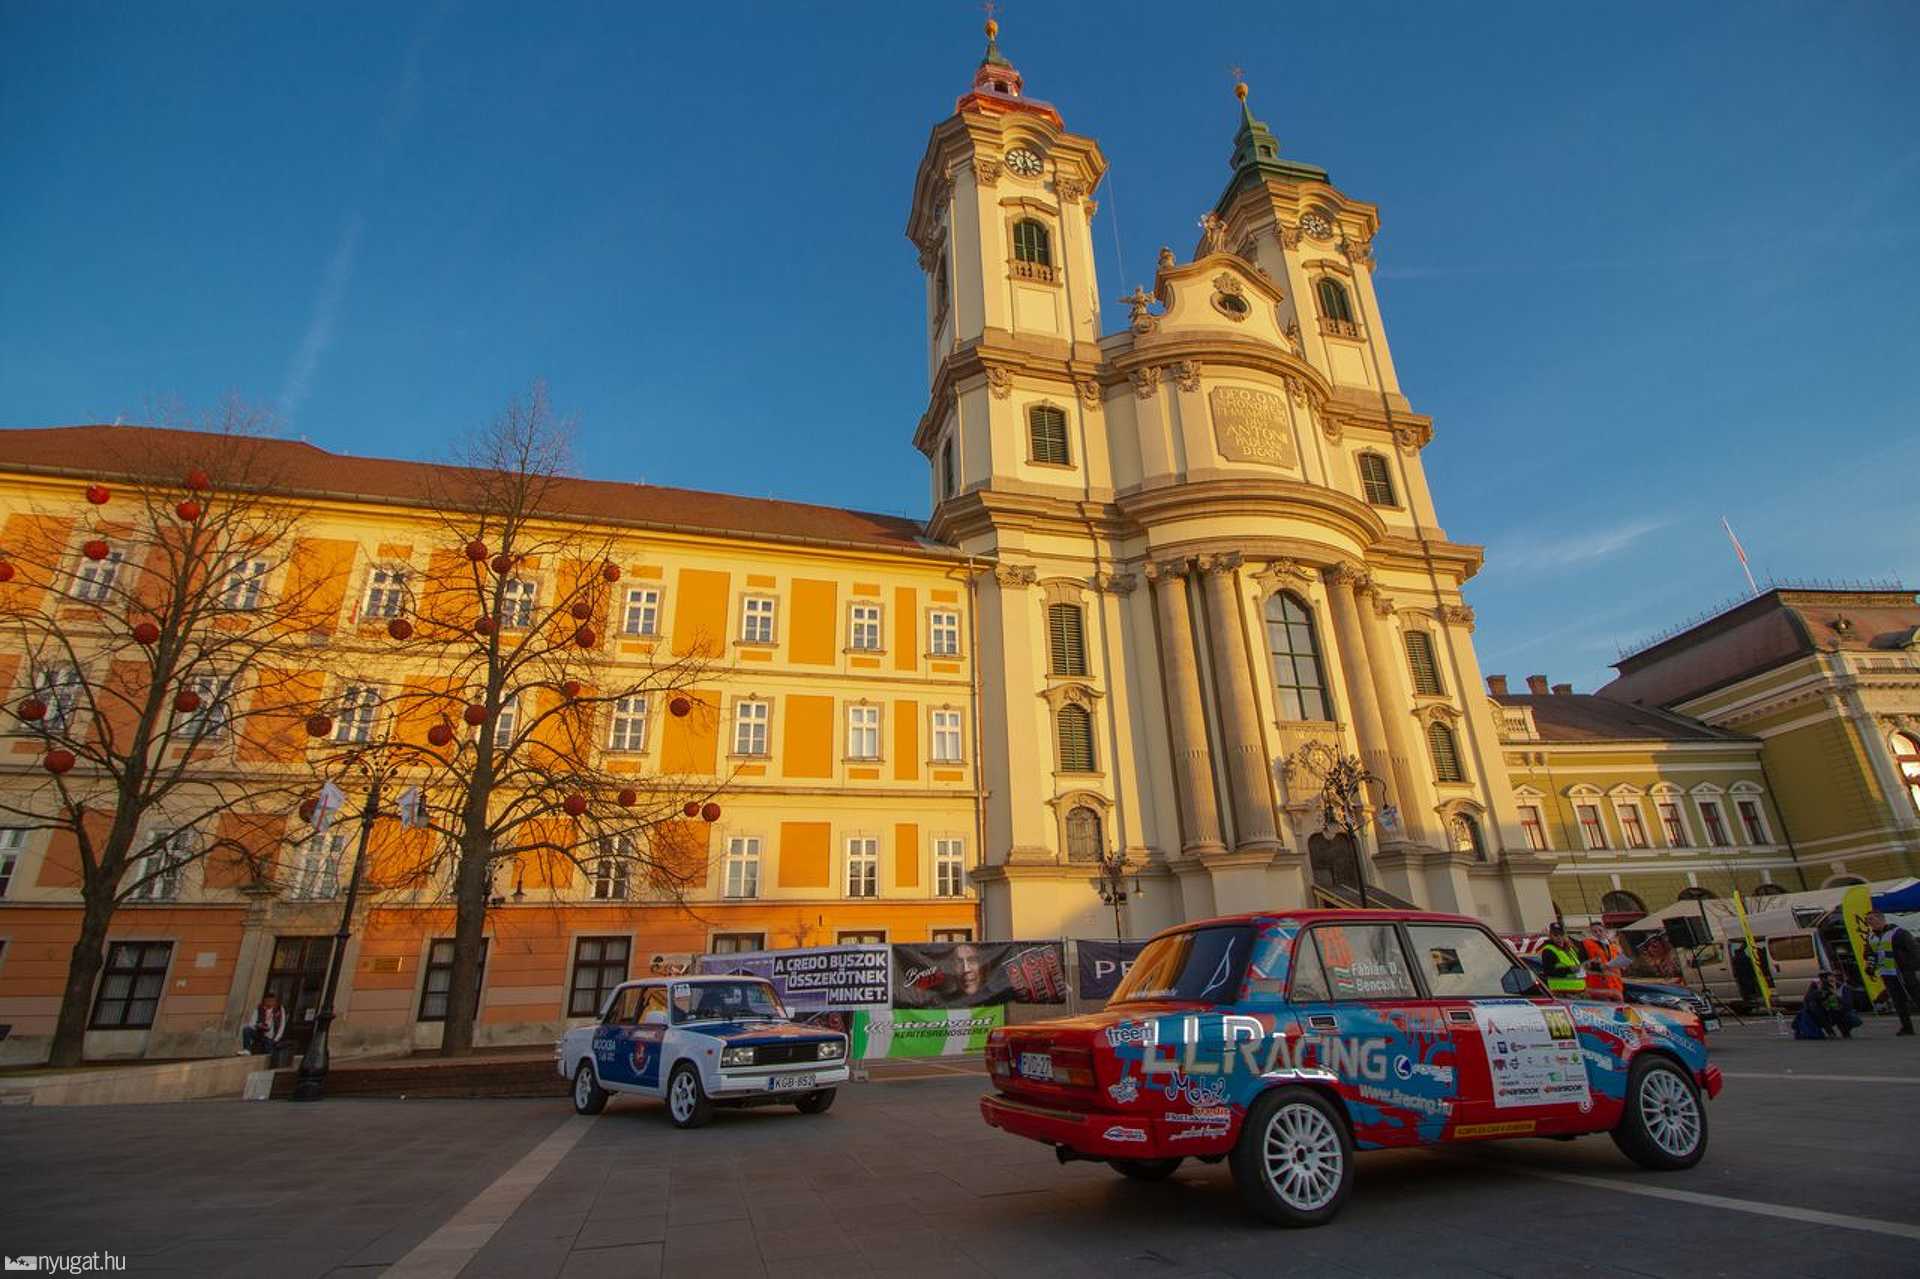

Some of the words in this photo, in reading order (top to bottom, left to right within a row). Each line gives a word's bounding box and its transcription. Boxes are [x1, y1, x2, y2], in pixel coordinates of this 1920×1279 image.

[774, 957, 784, 973] A
[786, 955, 828, 972] CREDO
[830, 952, 887, 970] BUSZOK
[788, 969, 887, 988] ÖSSZEKÖTNEK
[827, 986, 888, 1002] MINKET.
